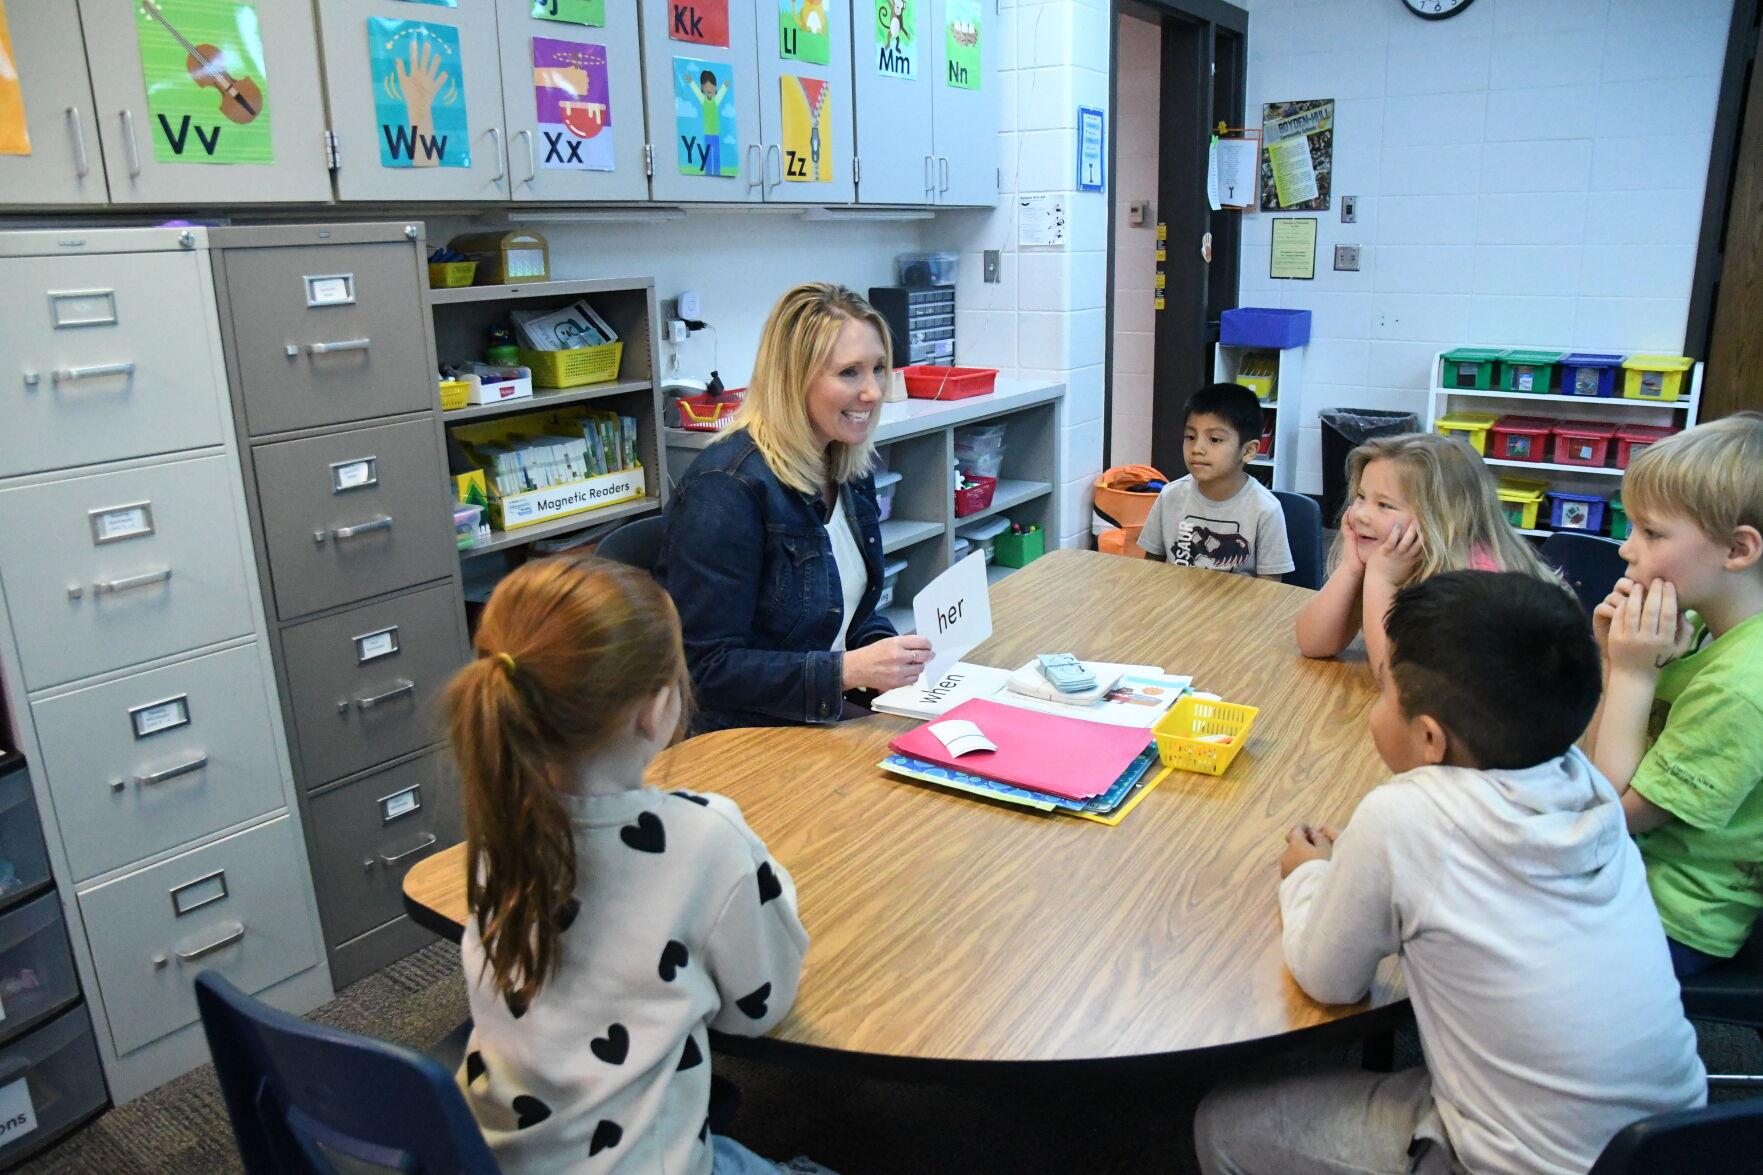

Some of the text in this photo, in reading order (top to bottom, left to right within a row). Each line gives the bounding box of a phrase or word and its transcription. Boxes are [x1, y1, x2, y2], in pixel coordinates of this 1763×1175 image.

[674, 4, 703, 39] Kk
[1434, 3, 1442, 12] 6
[783, 27, 797, 55] Ll
[879, 48, 911, 75] Mm
[948, 59, 968, 84] Nn
[157, 113, 222, 156] Vv
[382, 123, 449, 161] Ww
[543, 131, 584, 165] Xx
[681, 135, 711, 171] Yy
[786, 150, 807, 177] Zz
[537, 482, 630, 511] Magnetic Readers
[936, 598, 964, 634] her
[918, 674, 965, 704] when
